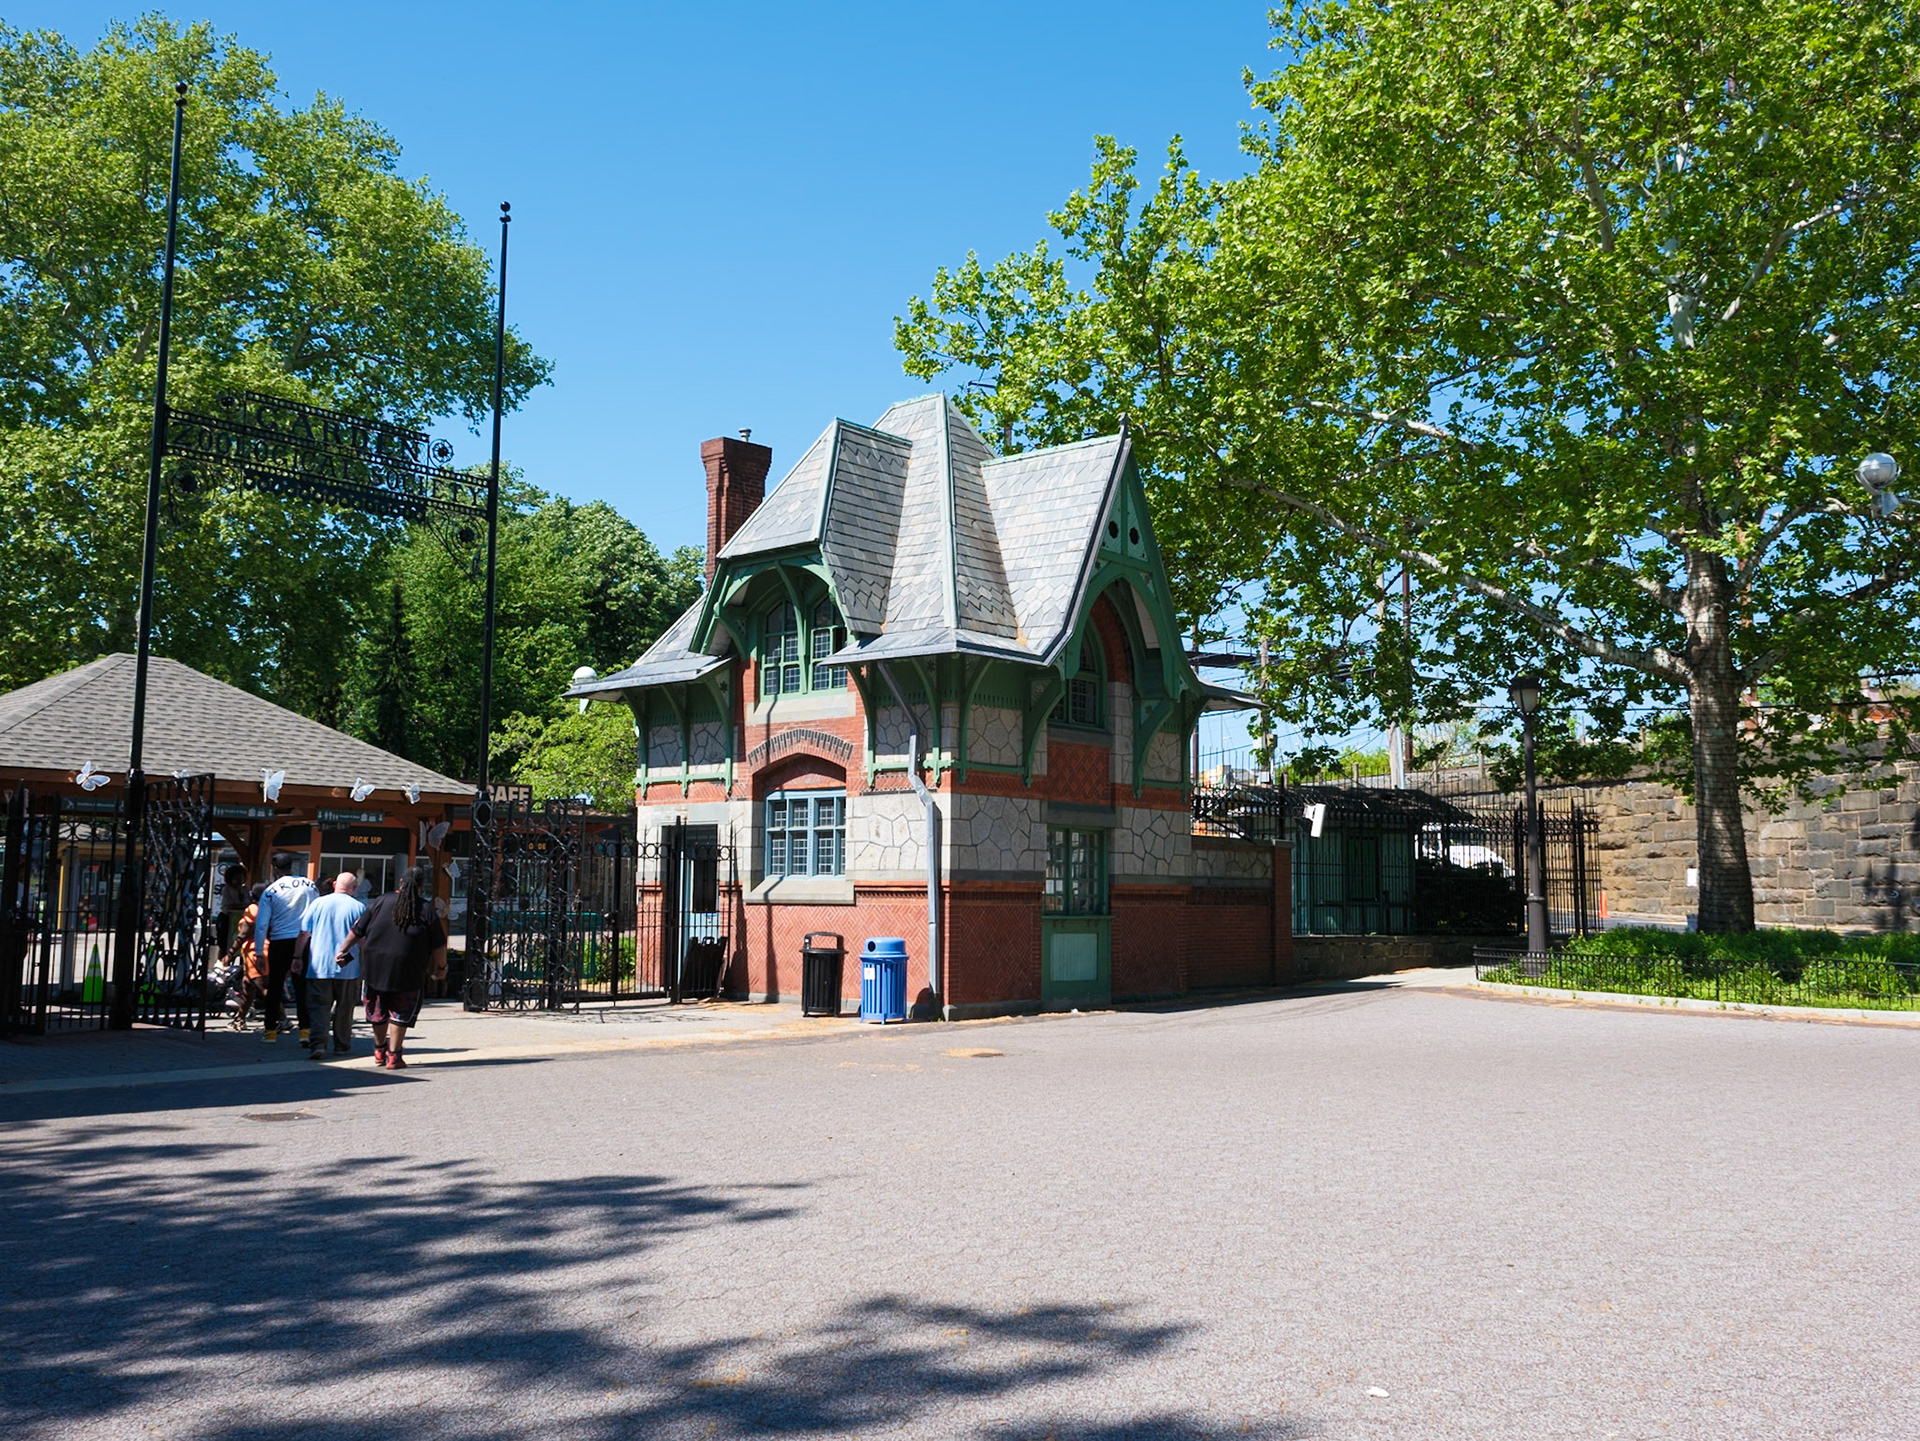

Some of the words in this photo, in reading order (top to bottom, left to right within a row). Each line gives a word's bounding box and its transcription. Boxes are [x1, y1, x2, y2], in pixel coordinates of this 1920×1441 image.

[171, 422, 355, 479] ZOOLOGICAL
[368, 467, 480, 504] SOCIETY
[256, 406, 421, 463] GARDEN
[349, 835, 369, 844] PICK
[370, 836, 382, 844] UP
